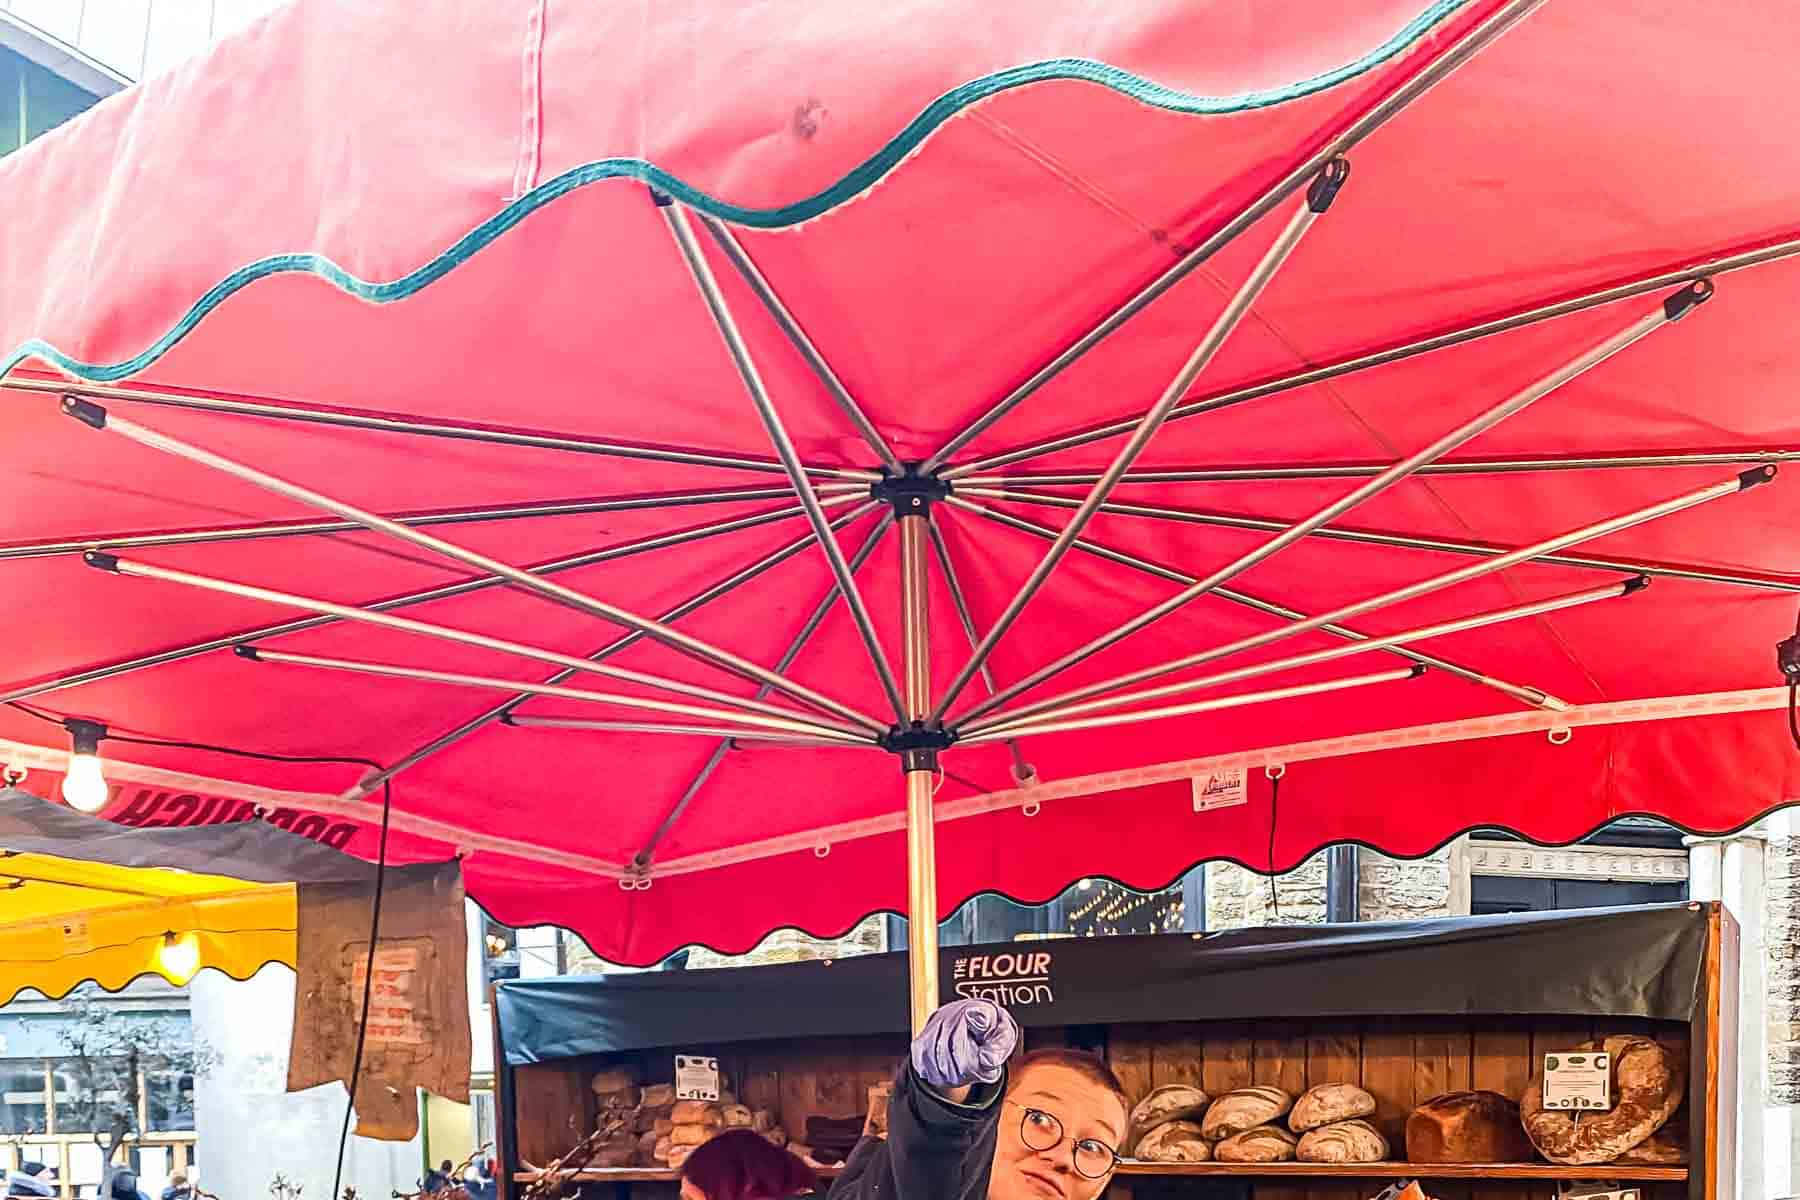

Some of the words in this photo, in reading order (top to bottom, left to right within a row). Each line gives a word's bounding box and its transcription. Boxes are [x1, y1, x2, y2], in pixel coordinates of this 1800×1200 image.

[954, 958, 968, 979] THE
[969, 953, 1051, 978] FLOUR
[955, 979, 1053, 1005] Station
